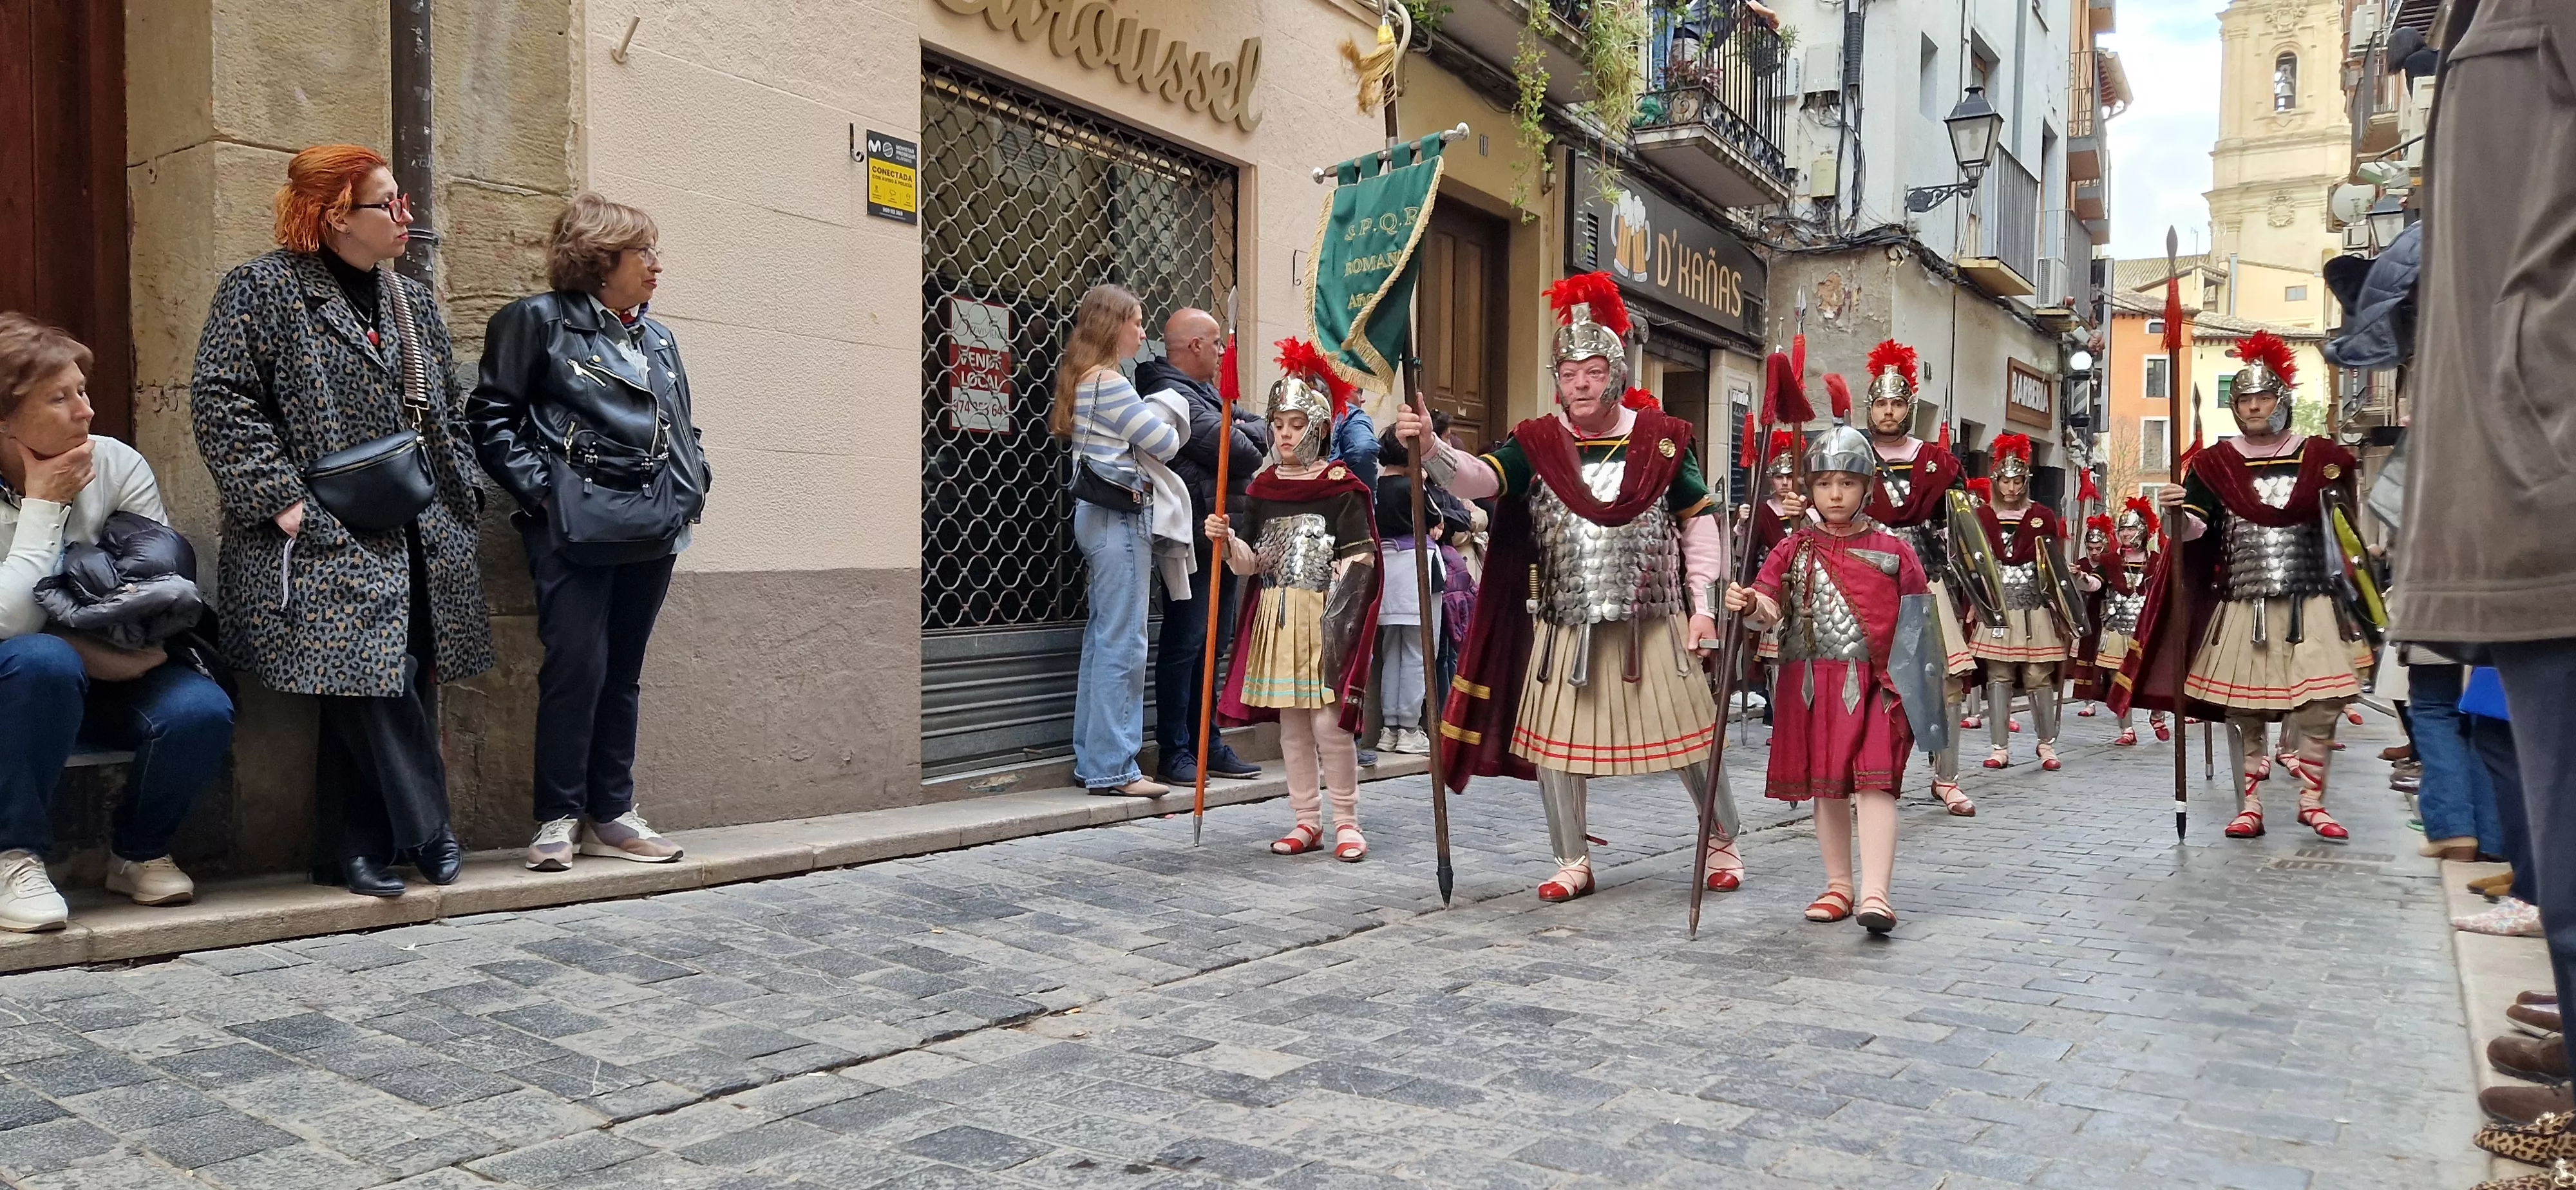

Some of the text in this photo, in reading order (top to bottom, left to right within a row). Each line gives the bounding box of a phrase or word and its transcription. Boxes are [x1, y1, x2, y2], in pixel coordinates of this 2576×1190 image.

[934, 0, 1262, 132] aroussel
[872, 165, 913, 182] CONECTADA
[1657, 228, 1741, 317] D'KAÑAS
[961, 370, 1000, 390] LOCAL
[953, 399, 970, 414] 974
